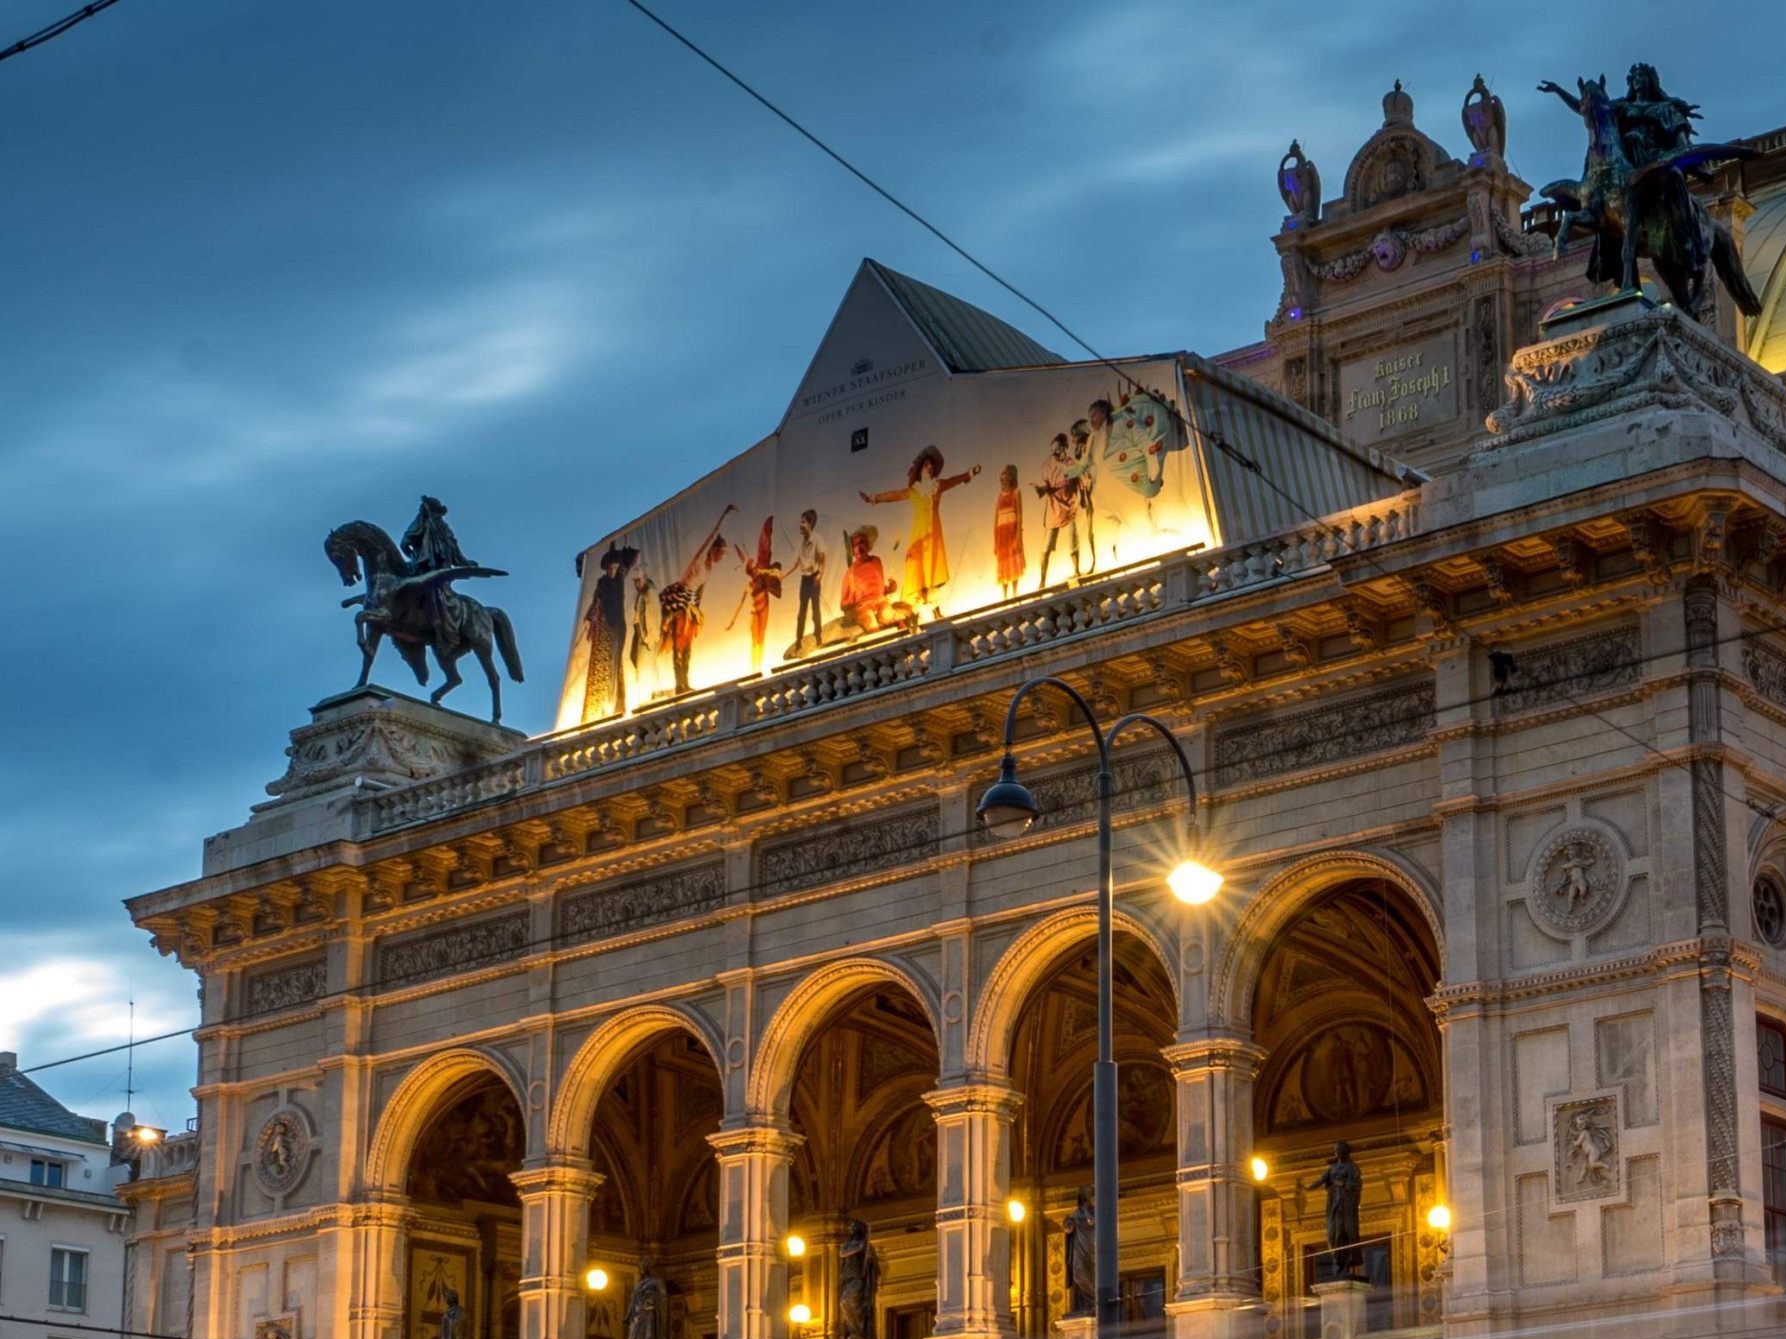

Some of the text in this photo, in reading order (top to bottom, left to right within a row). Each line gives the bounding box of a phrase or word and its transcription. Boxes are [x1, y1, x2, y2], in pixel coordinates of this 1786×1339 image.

[1374, 352, 1424, 381] Kaiser
[802, 359, 926, 407] WIENER STAATSOPER
[1345, 388, 1386, 420] Franz
[1388, 365, 1440, 401] Joseph
[868, 389, 906, 408] KINDER
[1380, 403, 1418, 430] 1868
